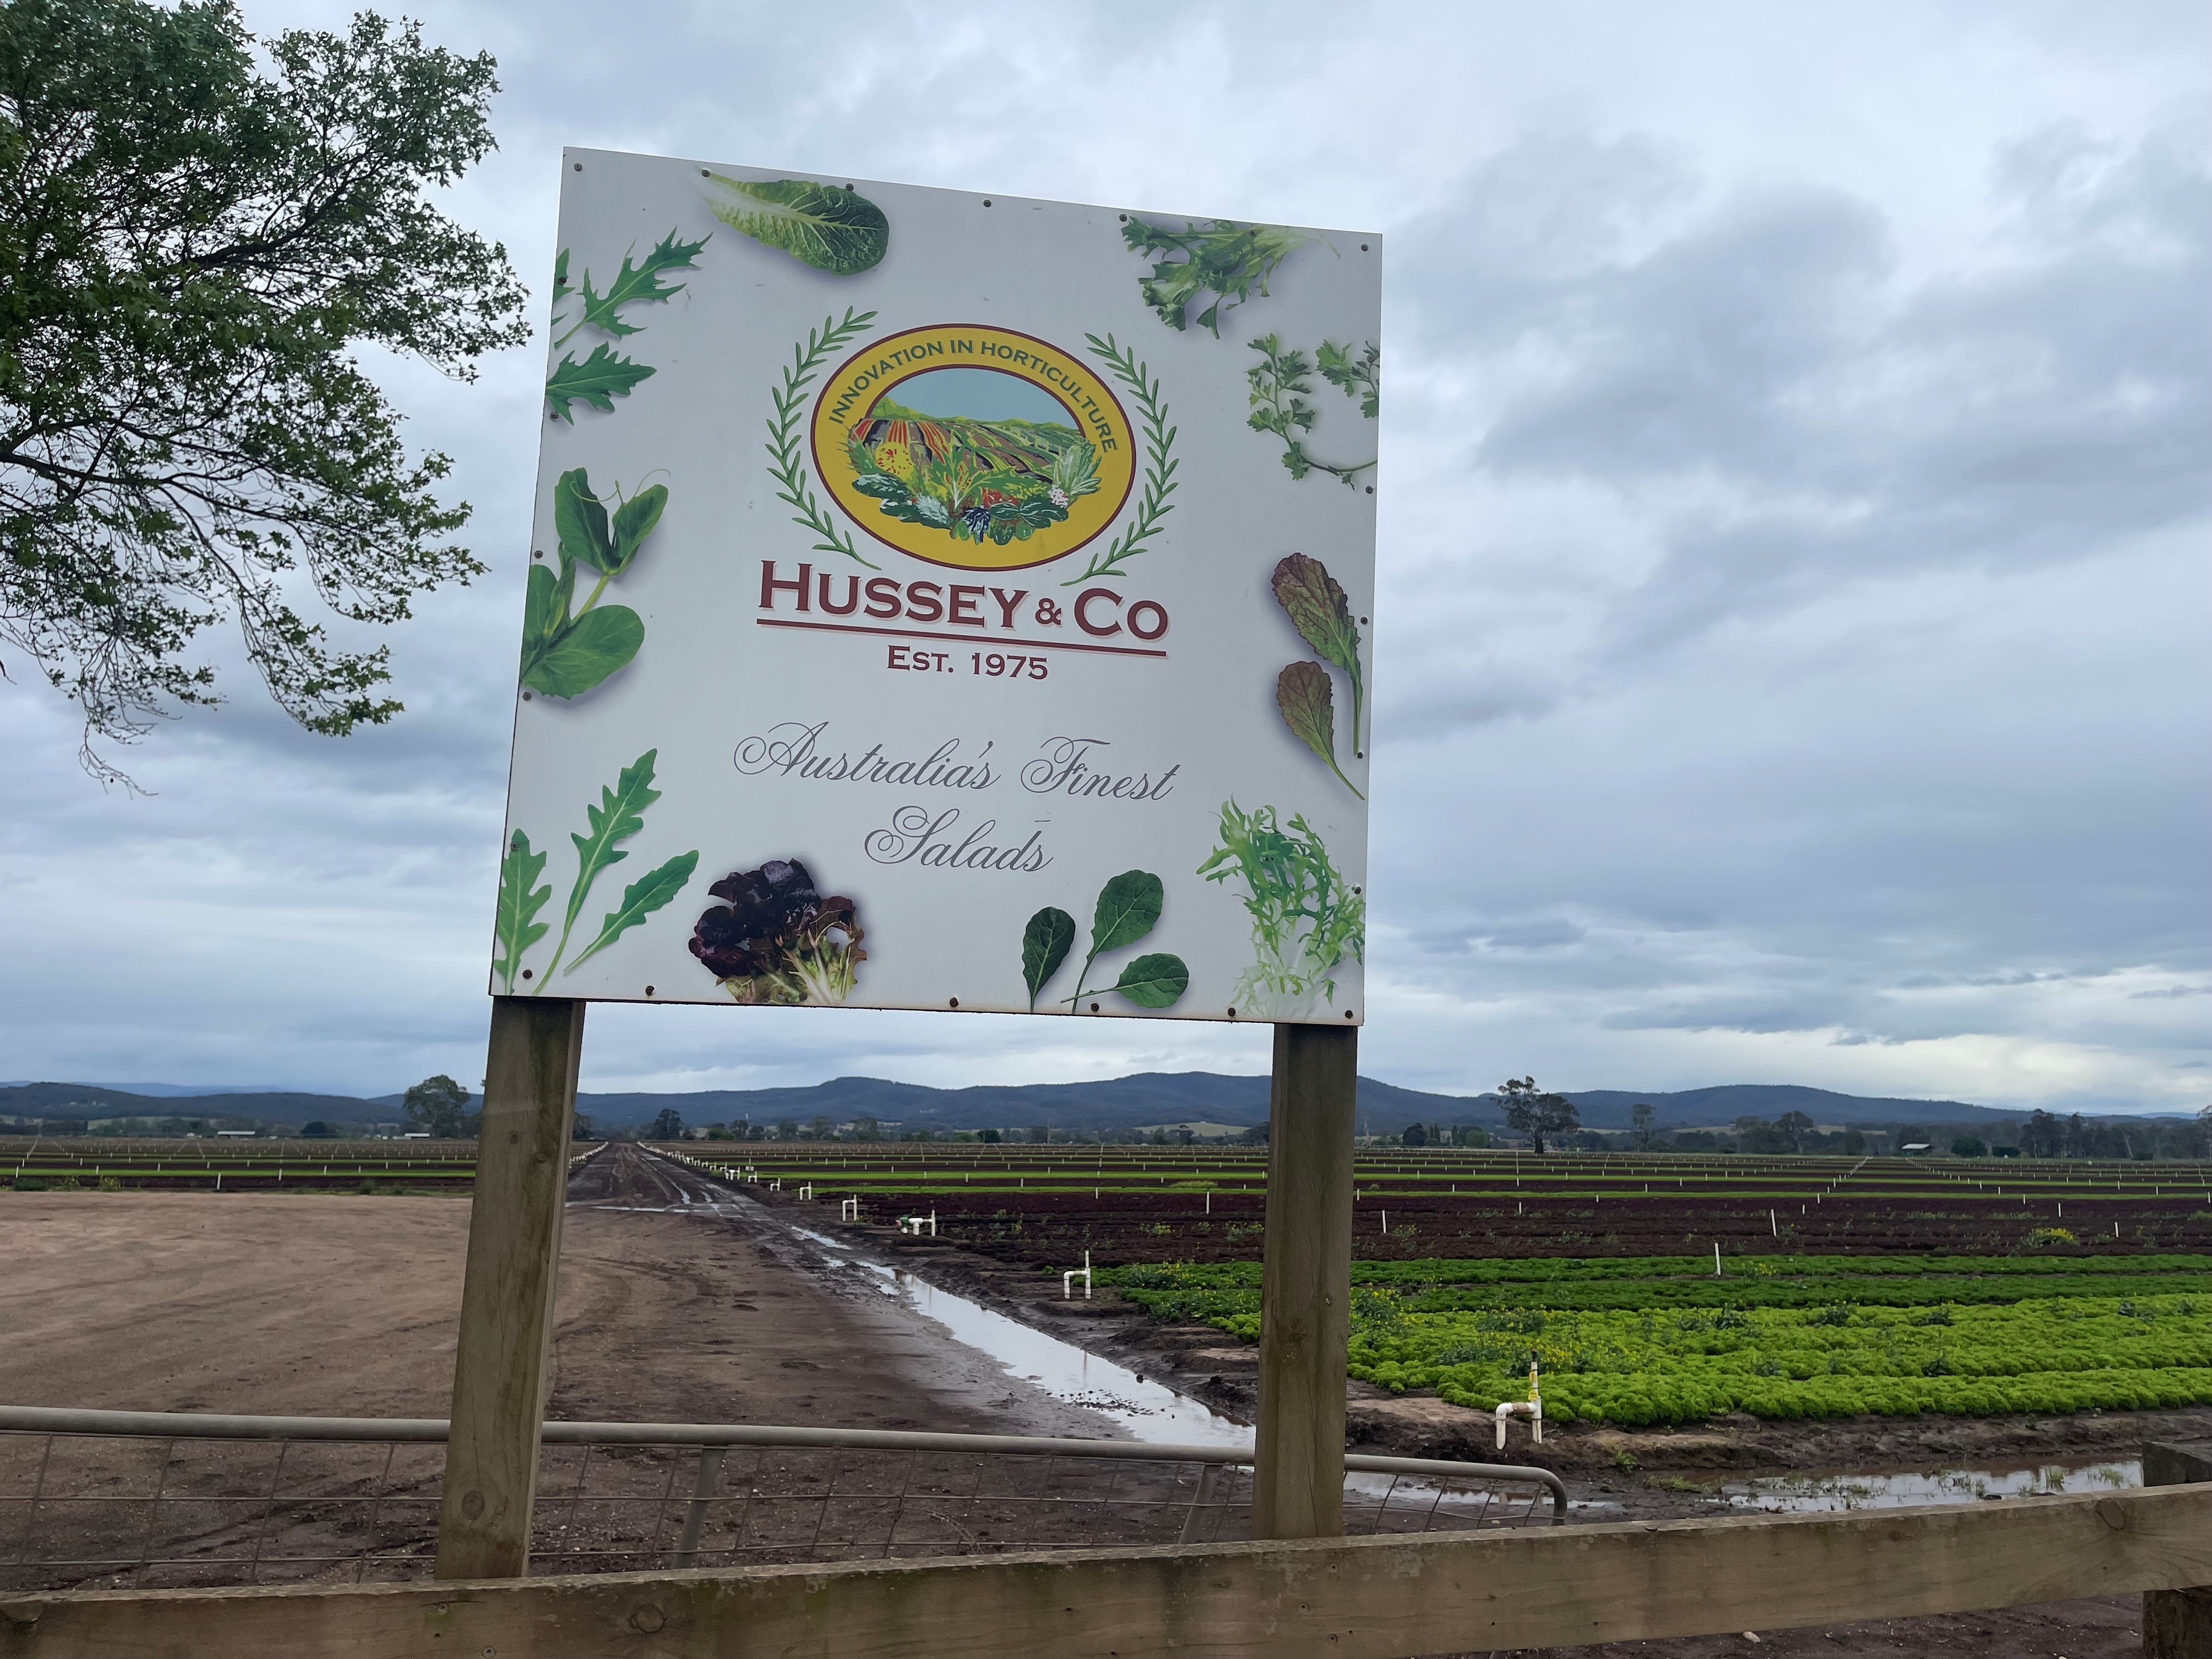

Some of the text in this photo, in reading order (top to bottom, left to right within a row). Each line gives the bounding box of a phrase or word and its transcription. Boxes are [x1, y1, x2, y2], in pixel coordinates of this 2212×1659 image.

[828, 340, 1118, 453] INNOVATION IN HORTICULTURE
[1035, 598, 1062, 625] &
[972, 652, 1048, 679] 1975
[733, 721, 1181, 800] Australia's Finest
